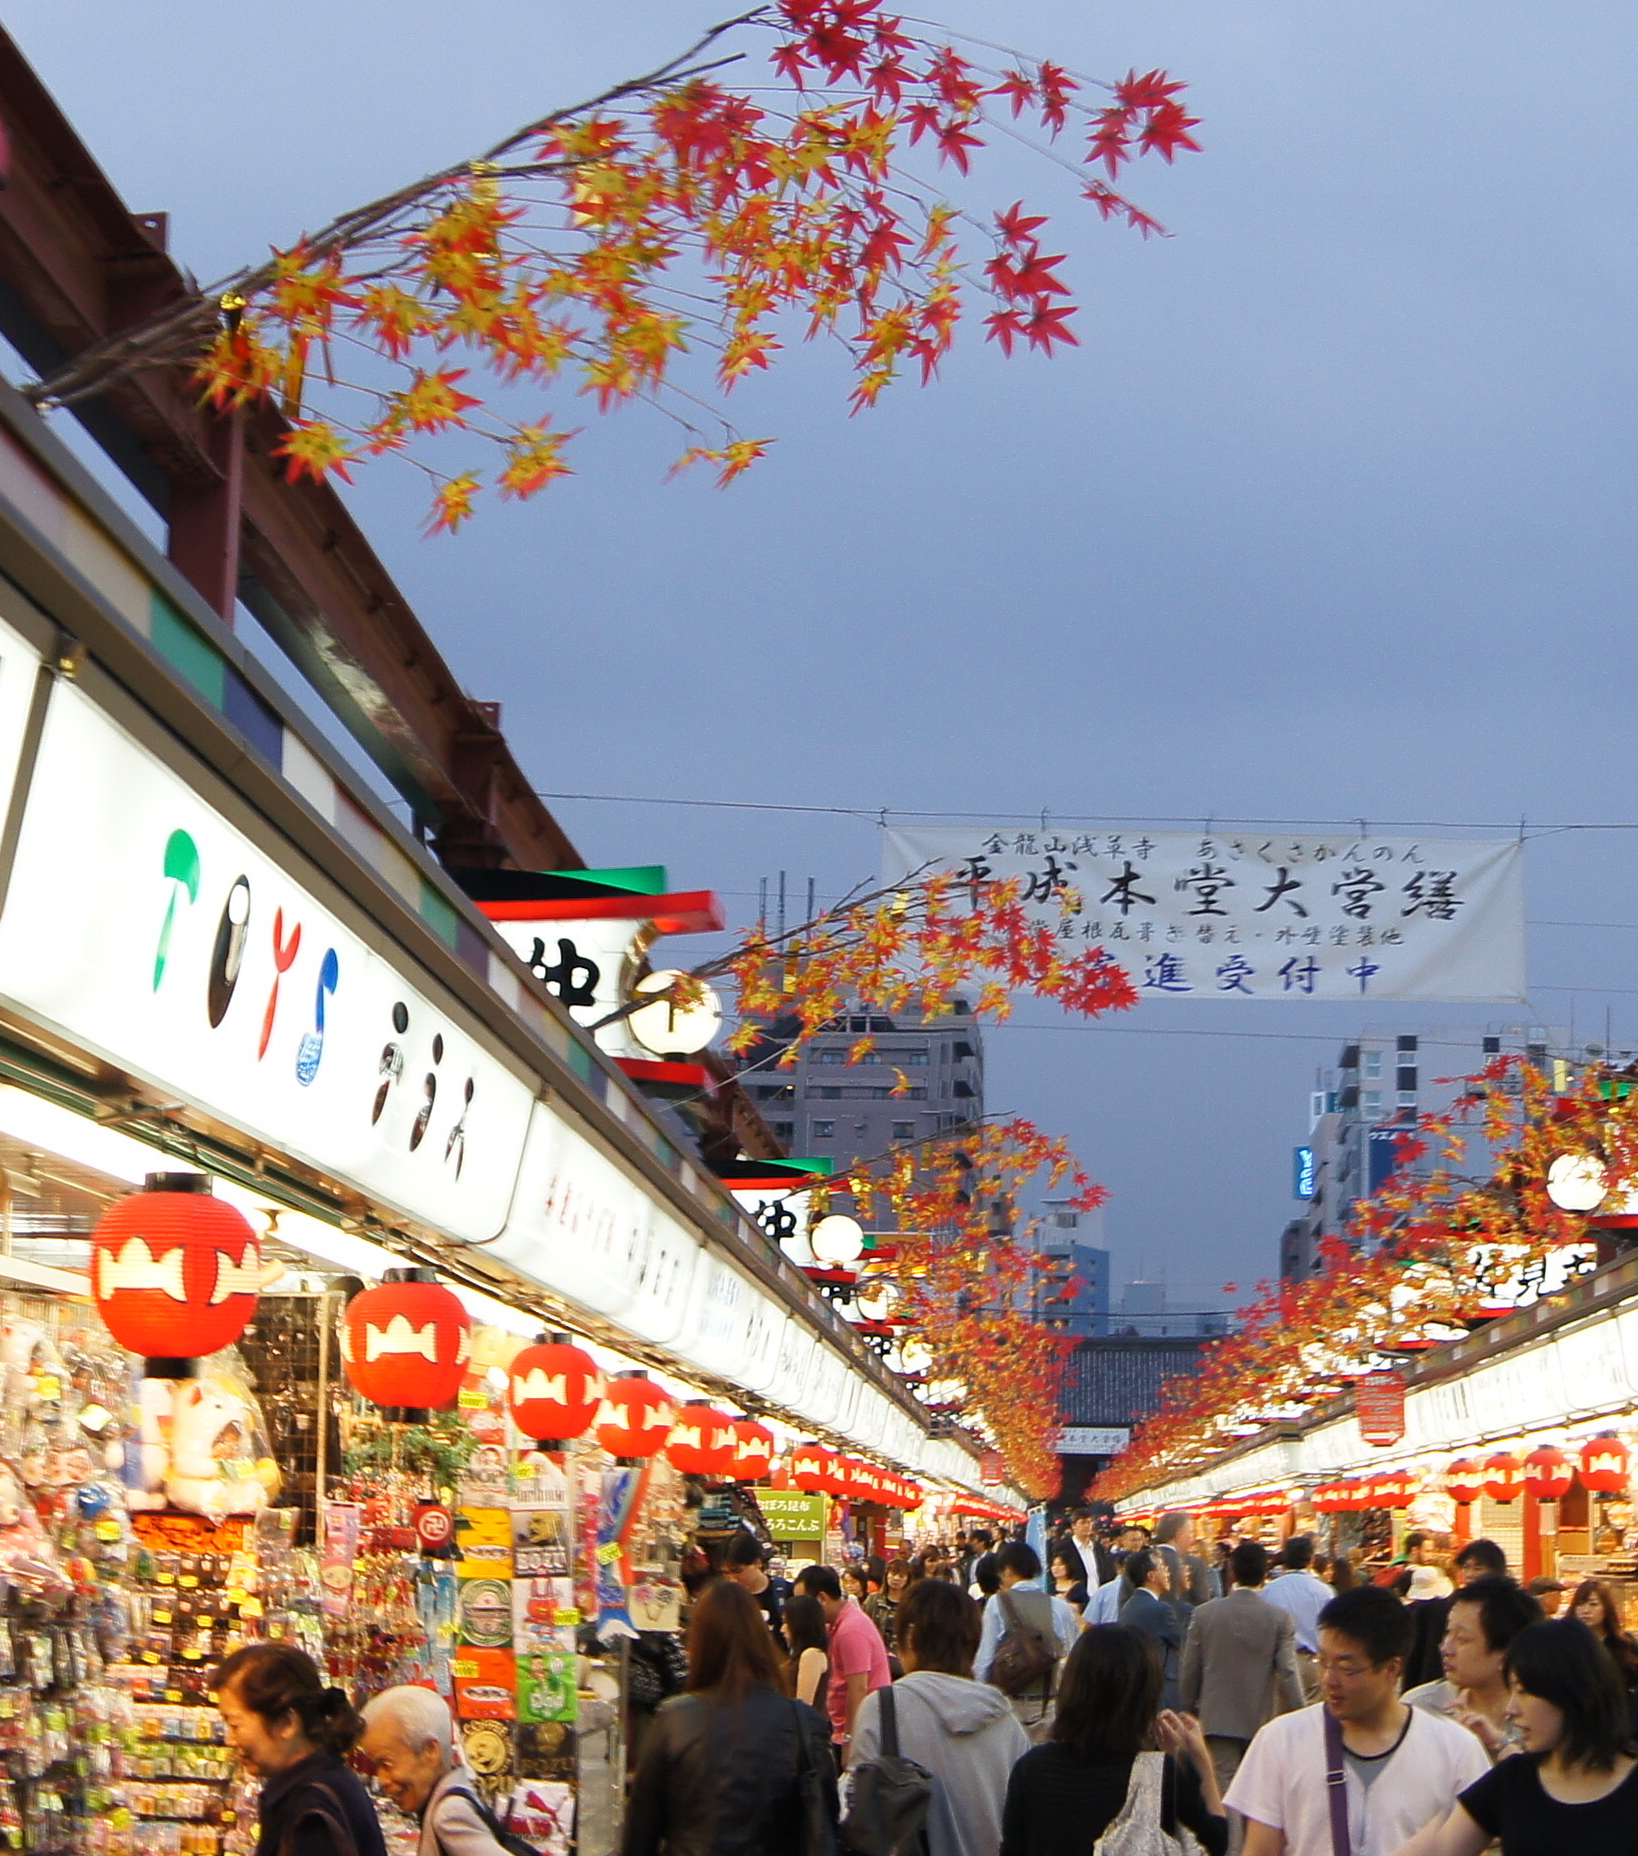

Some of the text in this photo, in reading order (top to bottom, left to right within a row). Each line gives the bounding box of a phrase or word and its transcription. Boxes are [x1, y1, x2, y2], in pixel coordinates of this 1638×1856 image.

[981, 832, 1426, 865] 金龍山浅草寺 あさくさかんのん
[153, 827, 339, 1087] TOYS
[766, 1518, 821, 1533] ろろこんぶ
